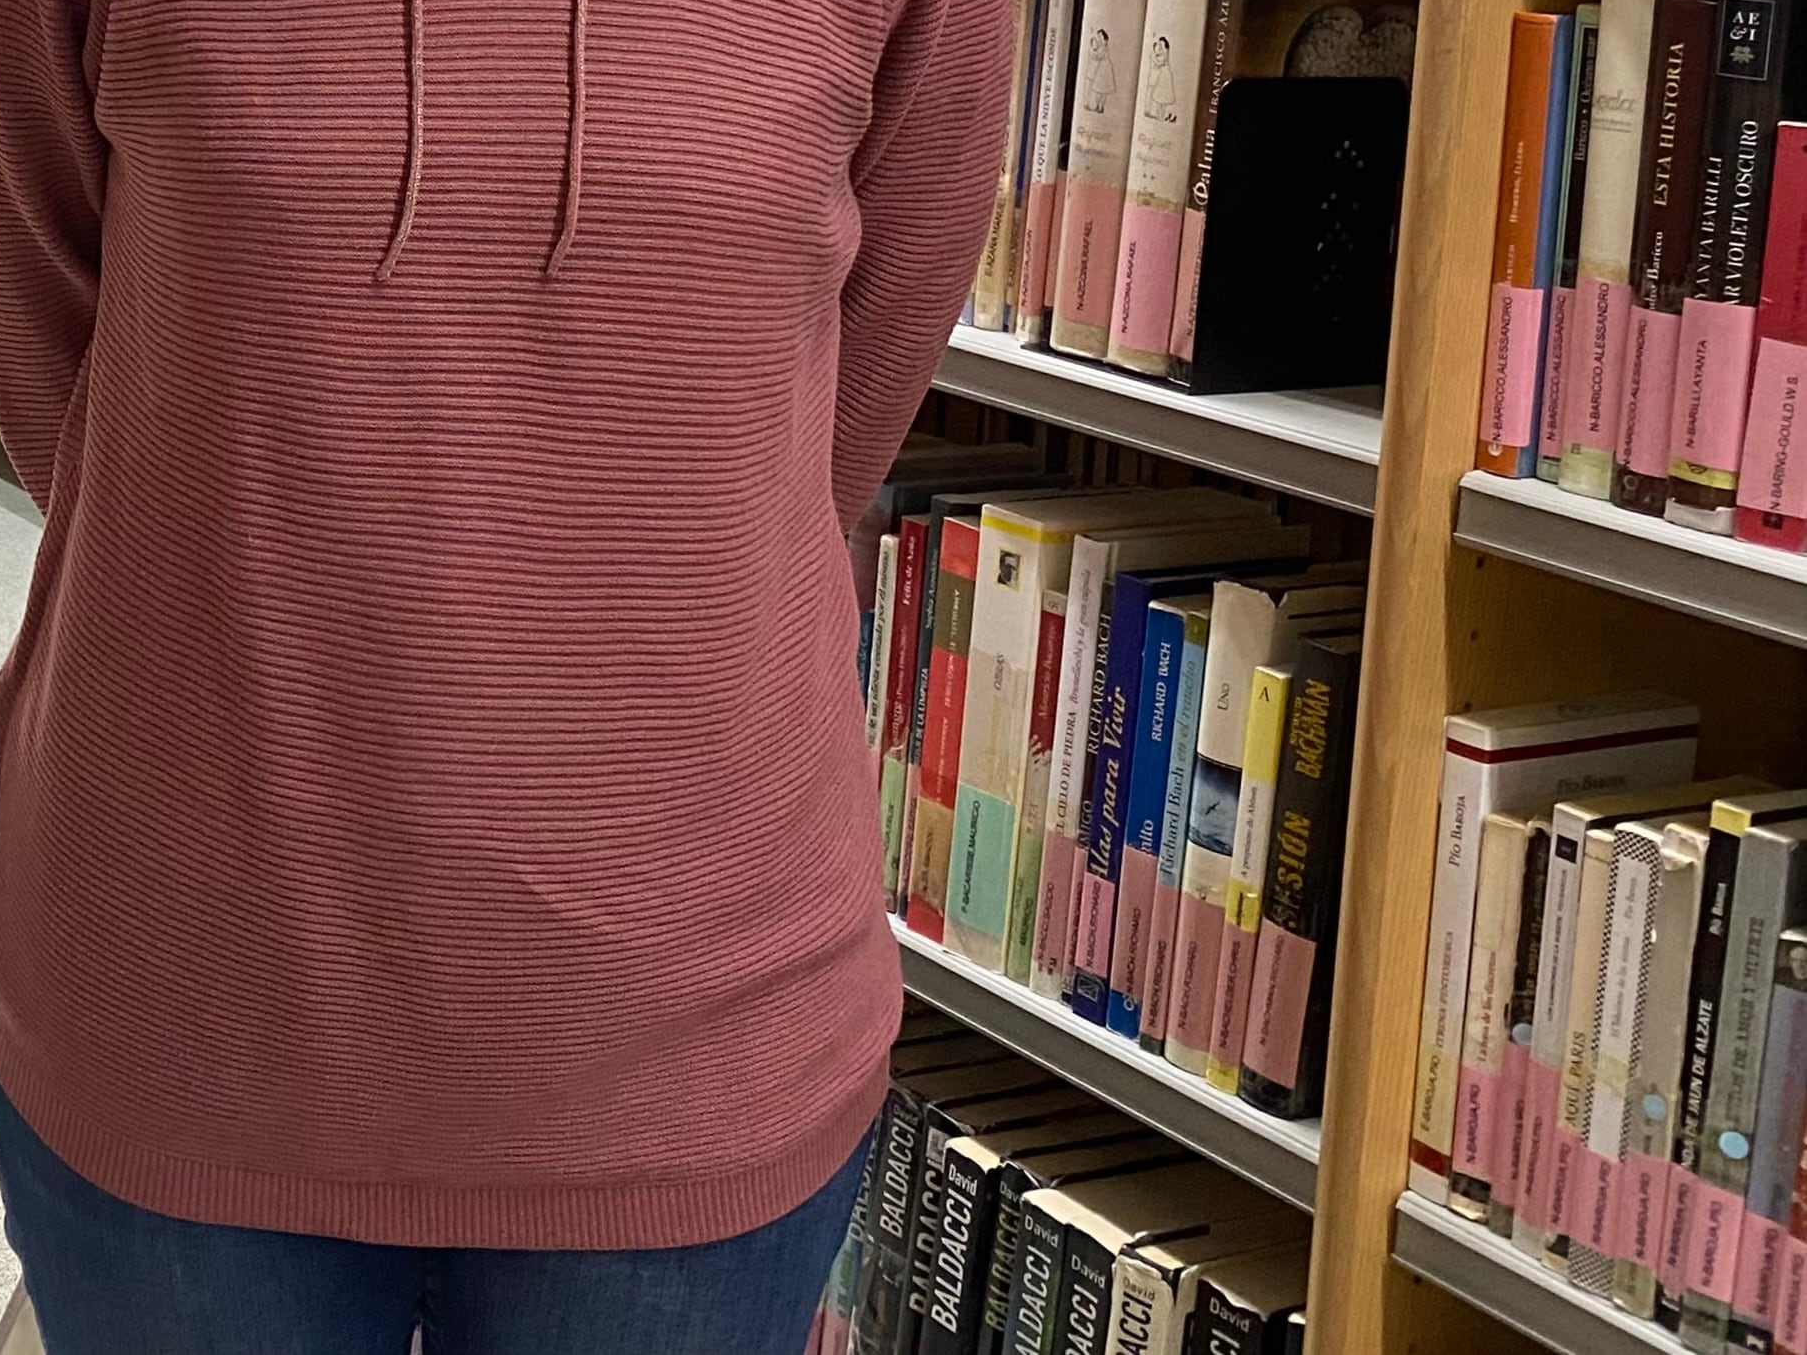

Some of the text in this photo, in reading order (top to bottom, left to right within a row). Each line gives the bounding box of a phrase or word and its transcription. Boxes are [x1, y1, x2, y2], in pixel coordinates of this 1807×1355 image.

[1654, 43, 1684, 206] ESTA HISTORIA
[1735, 120, 1759, 196] OSCURO
[1152, 642, 1172, 742] RICHARD BACH
[1099, 759, 1120, 827] para
[880, 1116, 917, 1239] BALDACCI
[948, 1163, 978, 1197] David
[931, 1189, 973, 1333] BALDACCI
[1025, 1214, 1059, 1248] David
[1015, 1246, 1053, 1355] ALDACCI
[1071, 1255, 1106, 1289] David
[1209, 1297, 1250, 1332] David
